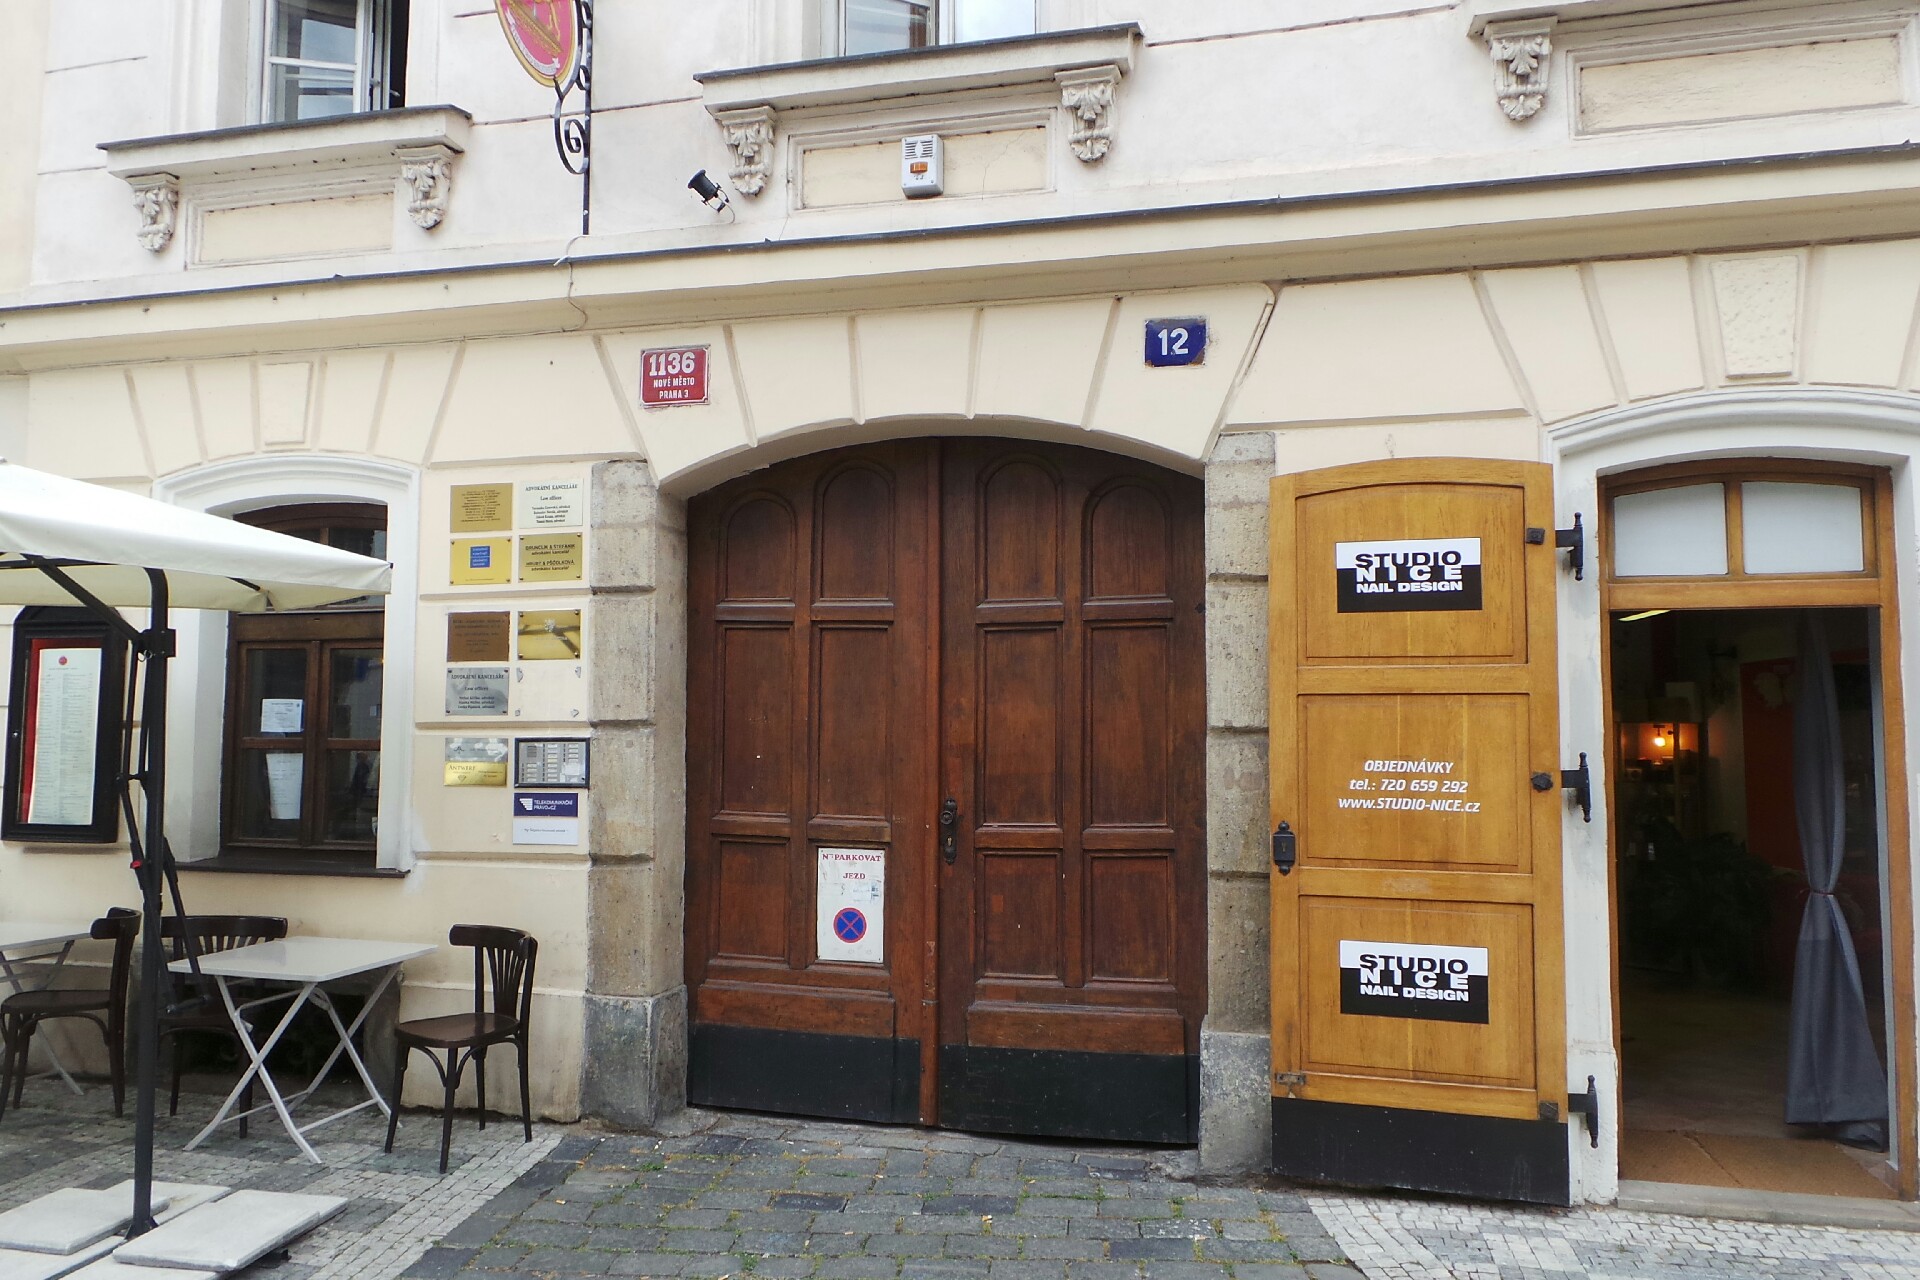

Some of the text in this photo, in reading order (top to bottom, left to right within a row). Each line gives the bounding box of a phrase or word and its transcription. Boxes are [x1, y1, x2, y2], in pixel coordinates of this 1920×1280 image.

[1158, 327, 1189, 356] 12
[649, 351, 696, 376] 1136
[653, 375, 695, 388] NOVÉ MĚSTO
[659, 389, 689, 399] PRAHA 3
[1355, 551, 1462, 568] STUDIO
[1356, 565, 1462, 582] NICE
[1356, 581, 1463, 593] NAIL DESIGN
[1364, 758, 1454, 774] OBJEDNÁVKY
[1349, 779, 1469, 793] tel.: 720 659 292
[1338, 797, 1481, 813] www.STUDIO-NICE.cz
[822, 853, 881, 862] NPARKOVAT
[1359, 954, 1469, 975] STUDIO
[1360, 968, 1469, 990] NICE
[1360, 984, 1469, 1002] NAIL DESIGN
